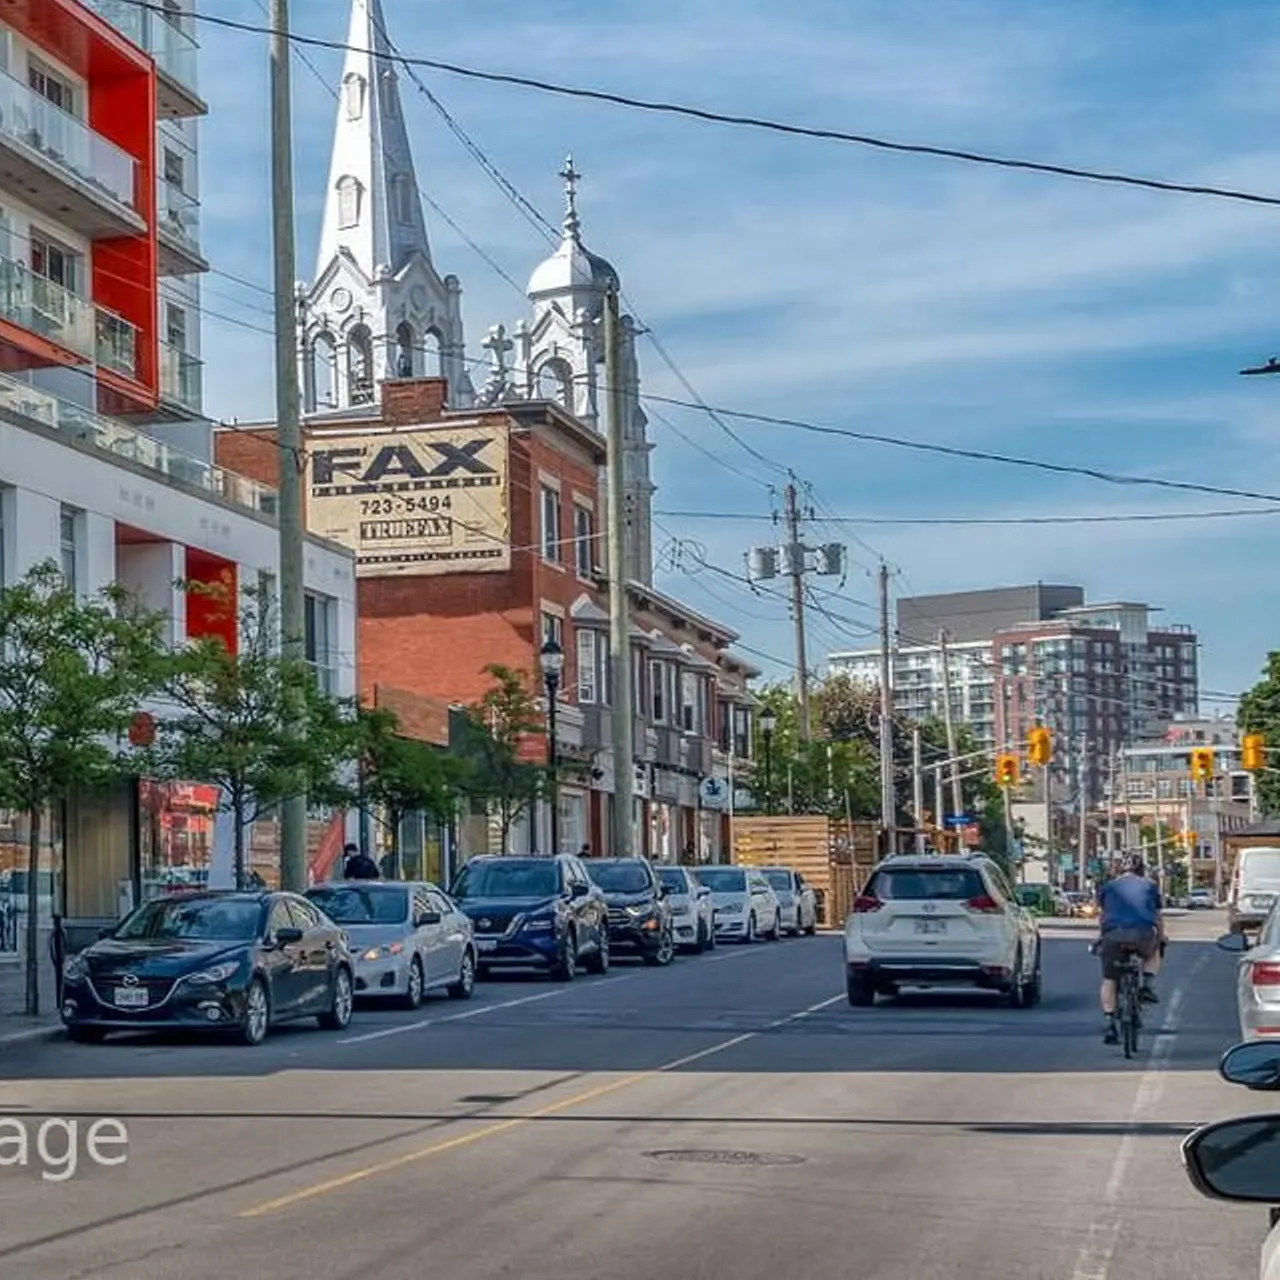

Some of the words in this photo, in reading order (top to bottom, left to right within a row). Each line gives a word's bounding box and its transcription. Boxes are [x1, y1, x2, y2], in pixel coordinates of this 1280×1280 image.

[312, 438, 498, 484] FAX
[360, 494, 452, 515] 723-5494
[362, 518, 452, 540] TRUEFAX
